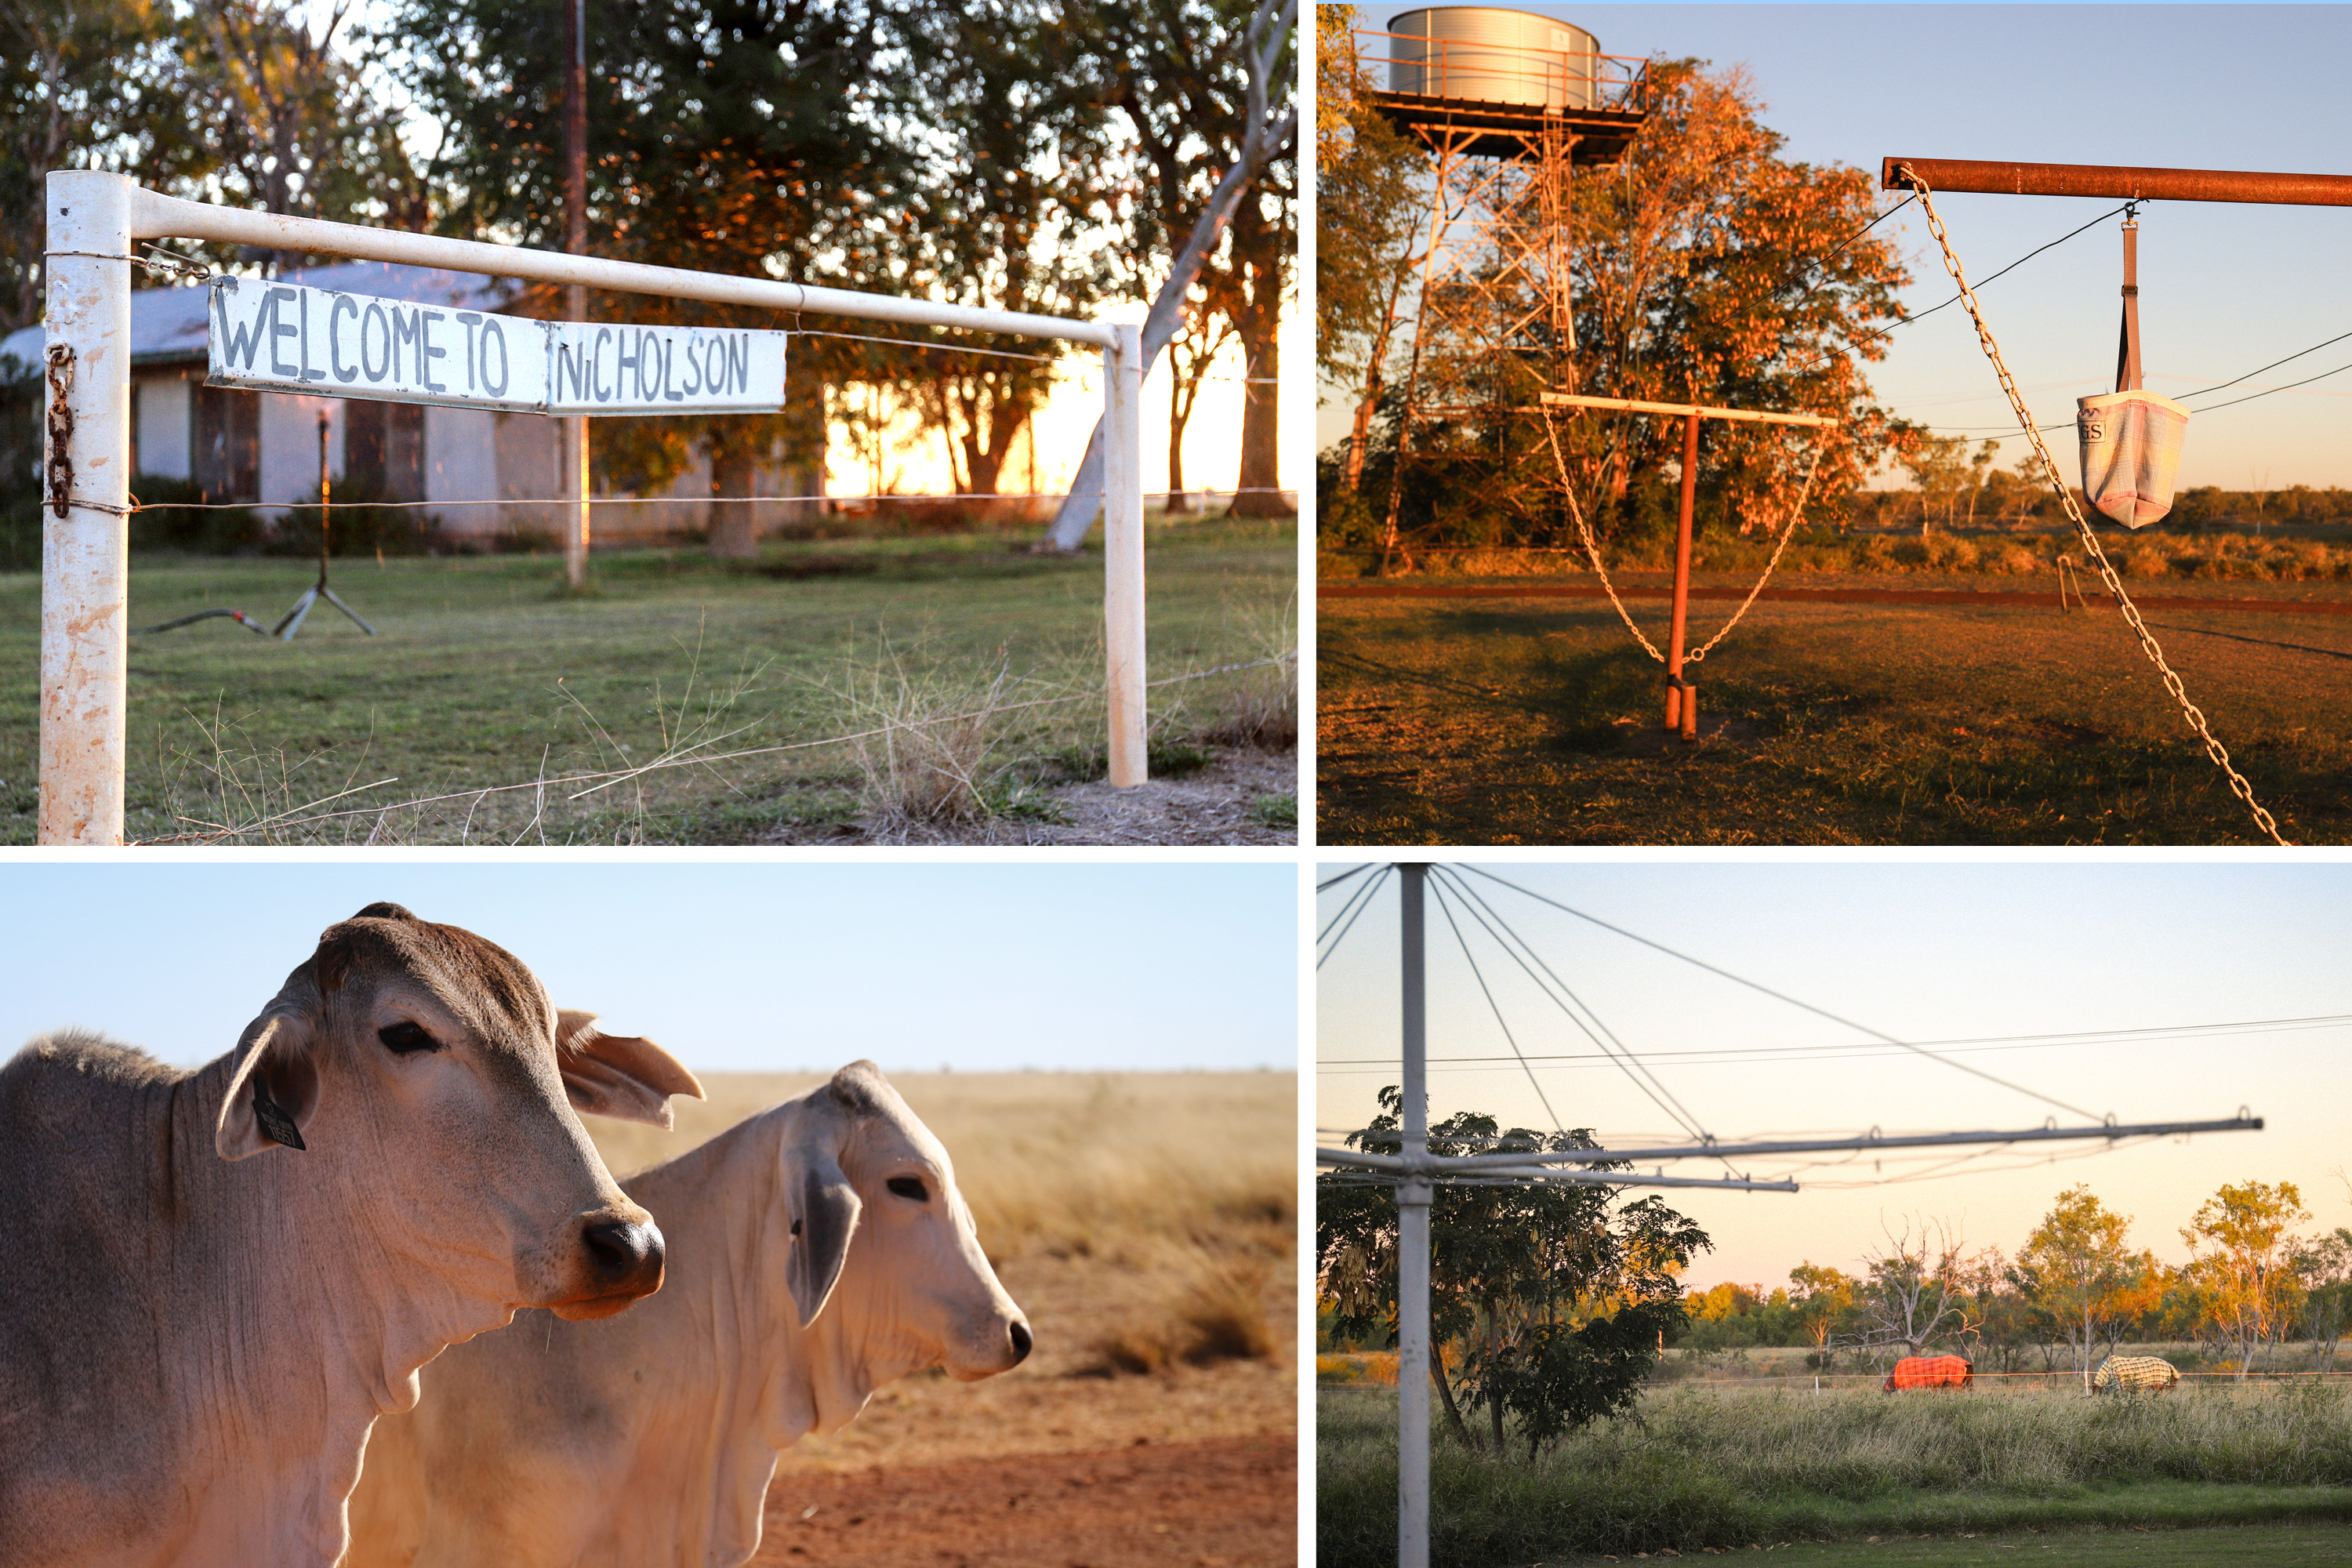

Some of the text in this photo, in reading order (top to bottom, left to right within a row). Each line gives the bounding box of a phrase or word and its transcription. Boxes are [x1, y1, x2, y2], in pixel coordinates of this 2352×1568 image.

[216, 285, 749, 403] WELCOME TO NICHOLSON
[2078, 424, 2102, 439] GS
[268, 1124, 296, 1147] 11557
